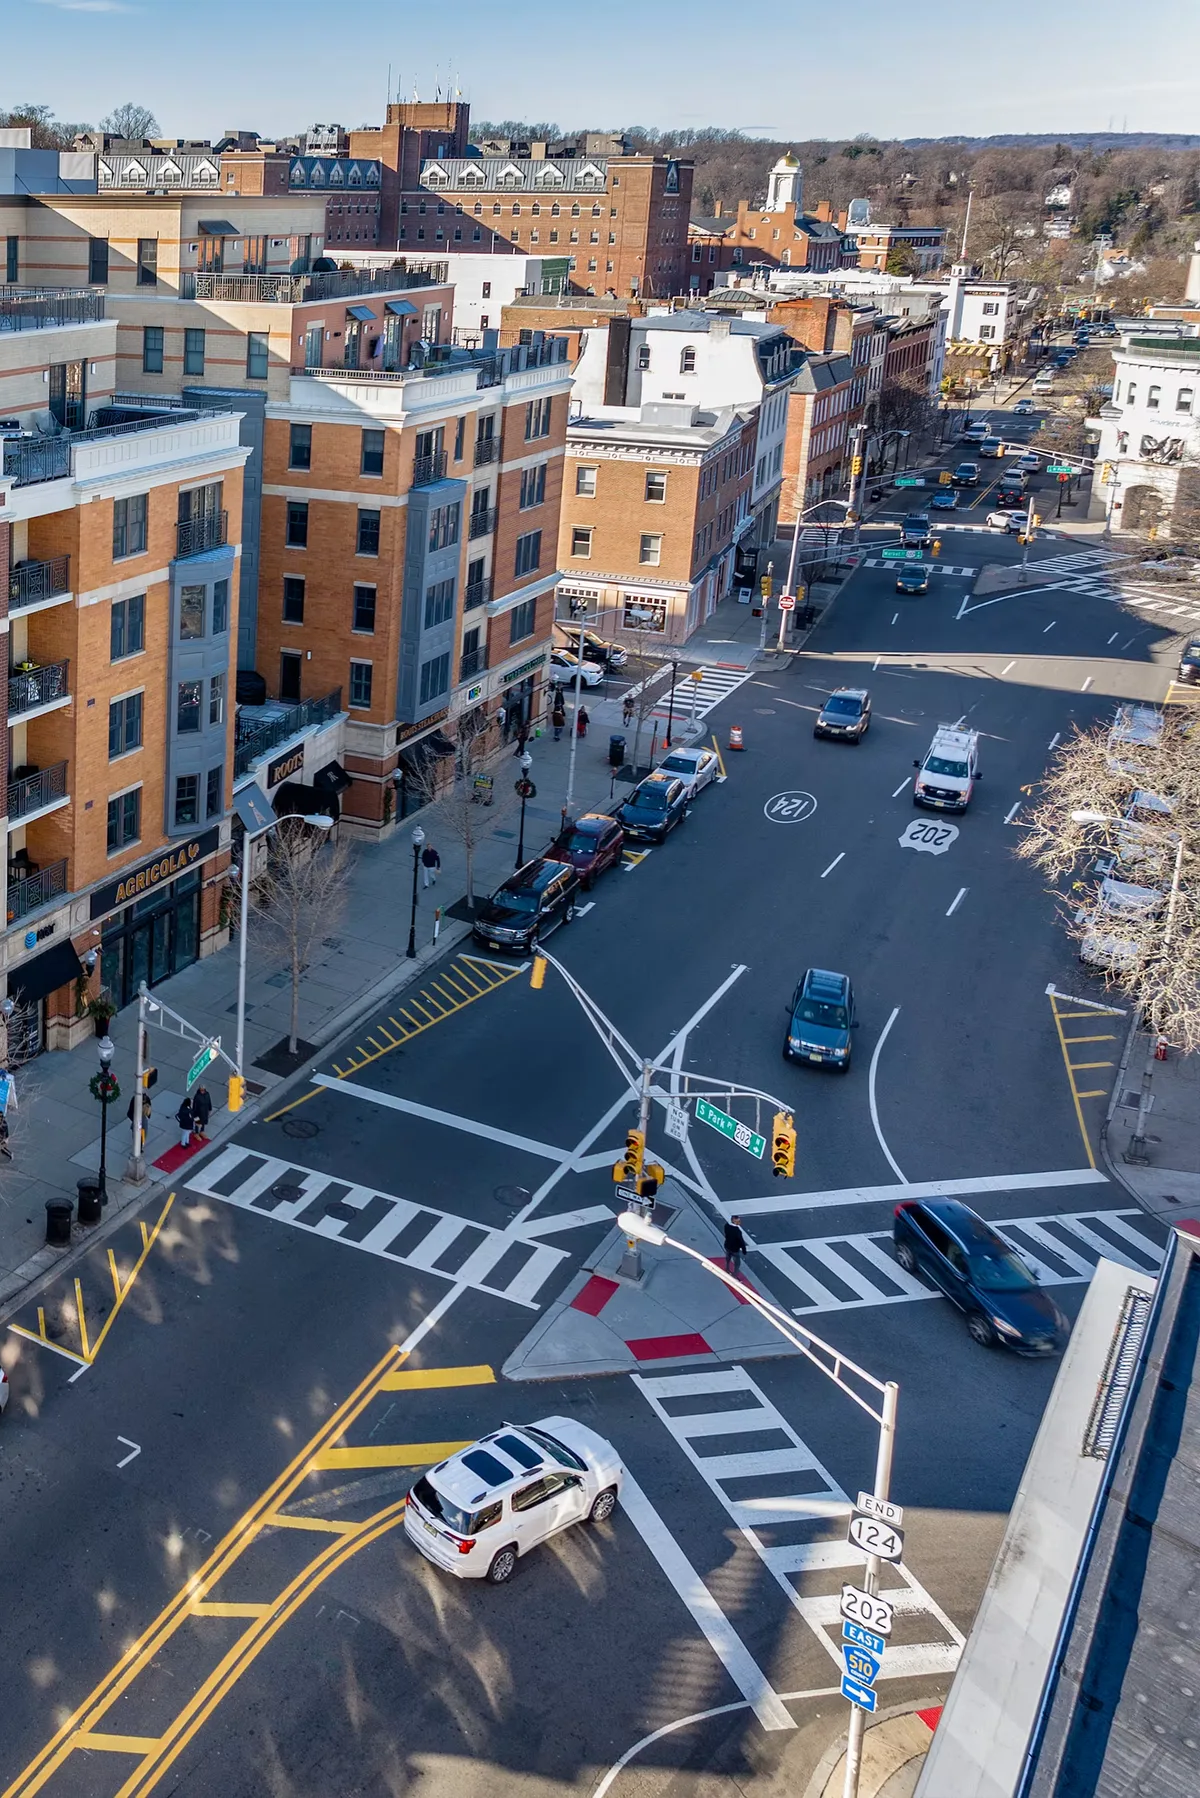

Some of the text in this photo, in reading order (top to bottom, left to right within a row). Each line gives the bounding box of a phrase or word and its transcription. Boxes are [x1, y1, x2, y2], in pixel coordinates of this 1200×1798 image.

[273, 750, 304, 784] ROOTS
[770, 796, 809, 818] 124
[909, 823, 952, 846] 202
[115, 850, 187, 904] AGRICOLA
[672, 1108, 683, 1119] NO
[699, 1104, 706, 1115] S
[708, 1109, 725, 1129] Park
[735, 1128, 751, 1145] 202
[864, 1498, 896, 1519] END
[856, 1520, 896, 1554] 124
[845, 1592, 888, 1629] 202
[848, 1626, 880, 1650] EAST
[849, 1654, 873, 1677] 510
